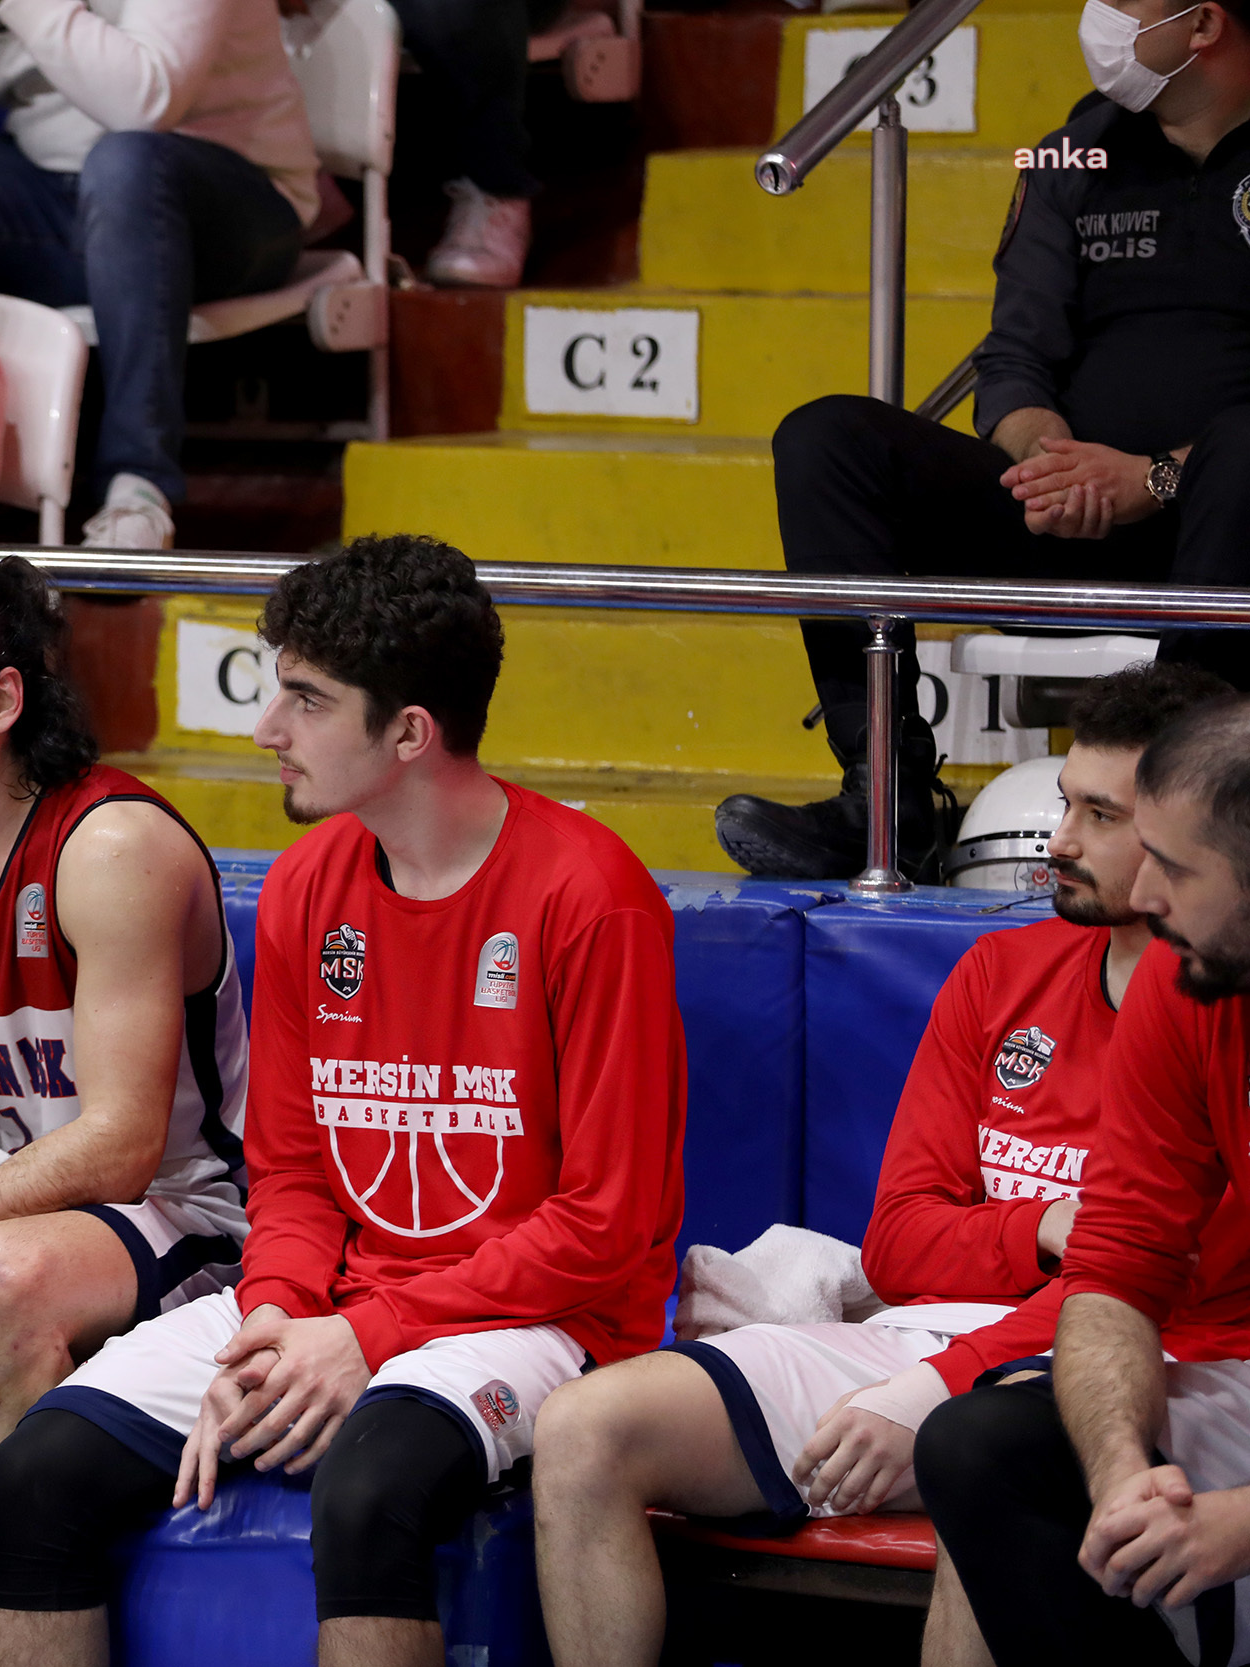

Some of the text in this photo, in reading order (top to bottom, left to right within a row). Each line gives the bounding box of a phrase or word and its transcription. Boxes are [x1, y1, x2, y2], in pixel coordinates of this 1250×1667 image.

[1111, 210, 1160, 235] KUVVET
[562, 333, 660, 395] C 2
[217, 646, 261, 706] C
[320, 957, 364, 980] MSK
[316, 1004, 363, 1024] Sporium
[310, 1055, 517, 1103] MERSİN MSK
[994, 1051, 1045, 1081] MSK
[317, 1103, 517, 1131] BASKETBALL
[990, 1096, 1025, 1115] orium
